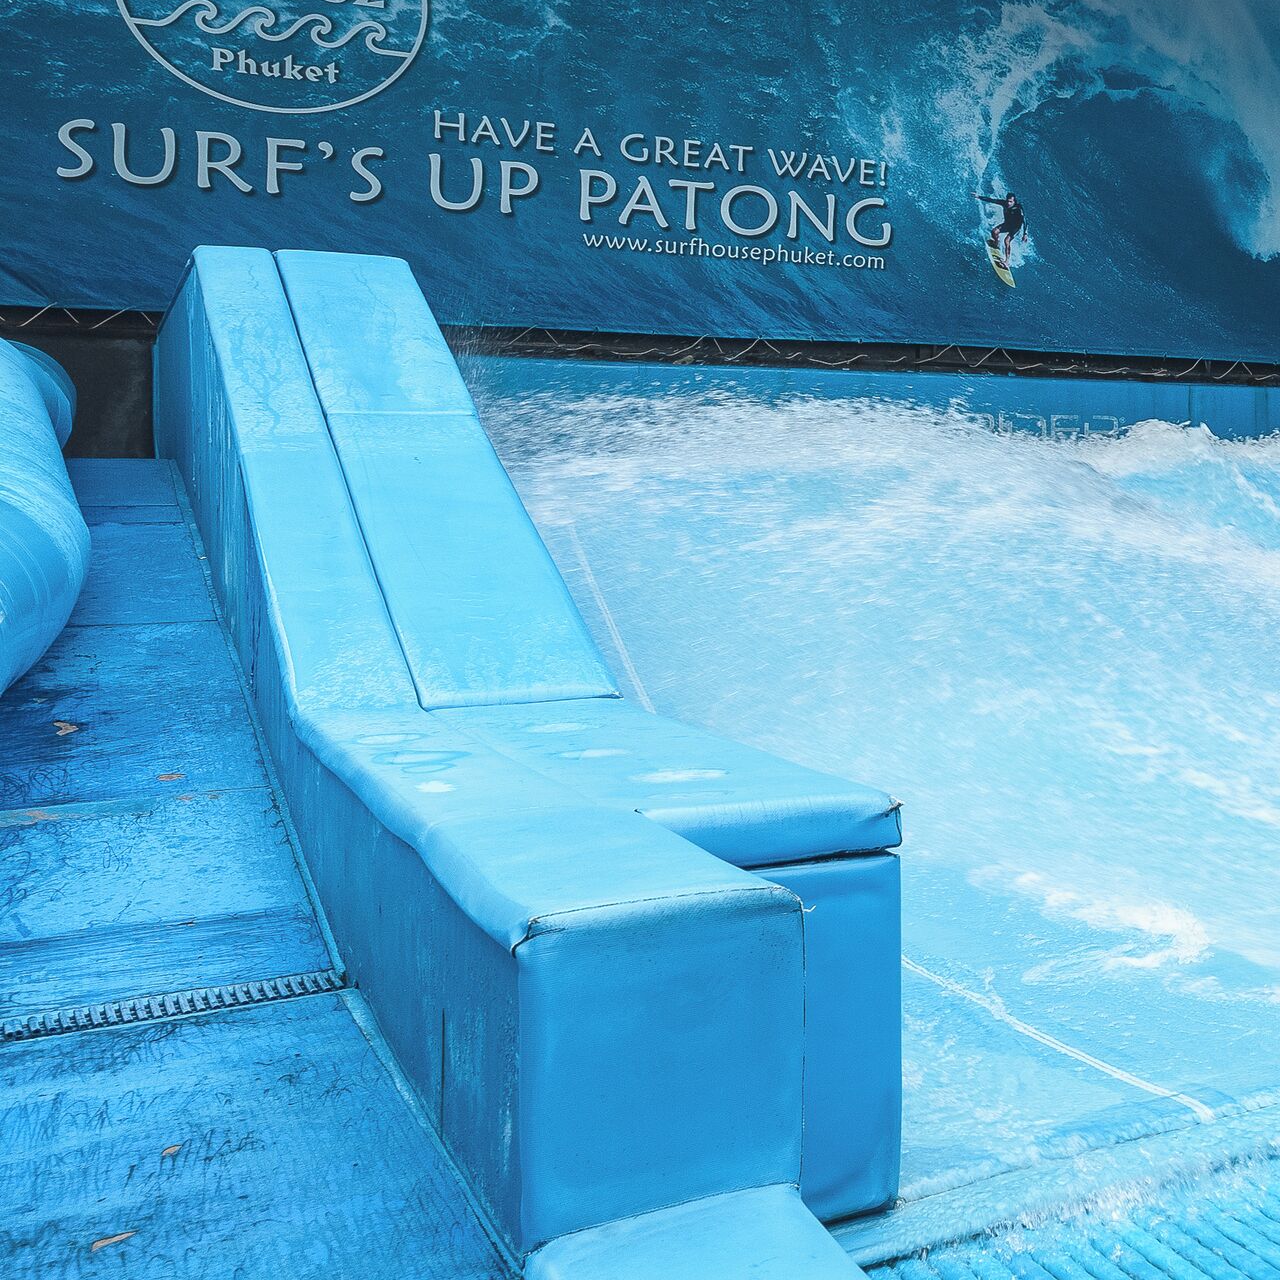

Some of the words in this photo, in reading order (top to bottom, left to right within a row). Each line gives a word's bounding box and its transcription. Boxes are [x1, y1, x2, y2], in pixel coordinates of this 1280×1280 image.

[211, 47, 339, 85] Phuket
[434, 110, 555, 151] HAVE
[574, 127, 602, 157] A
[620, 133, 753, 173] GREAT
[767, 148, 887, 187] WAVE!
[428, 153, 539, 214] UP
[579, 170, 892, 247] PATONG
[583, 232, 885, 270] www.surfhousephuket.com
